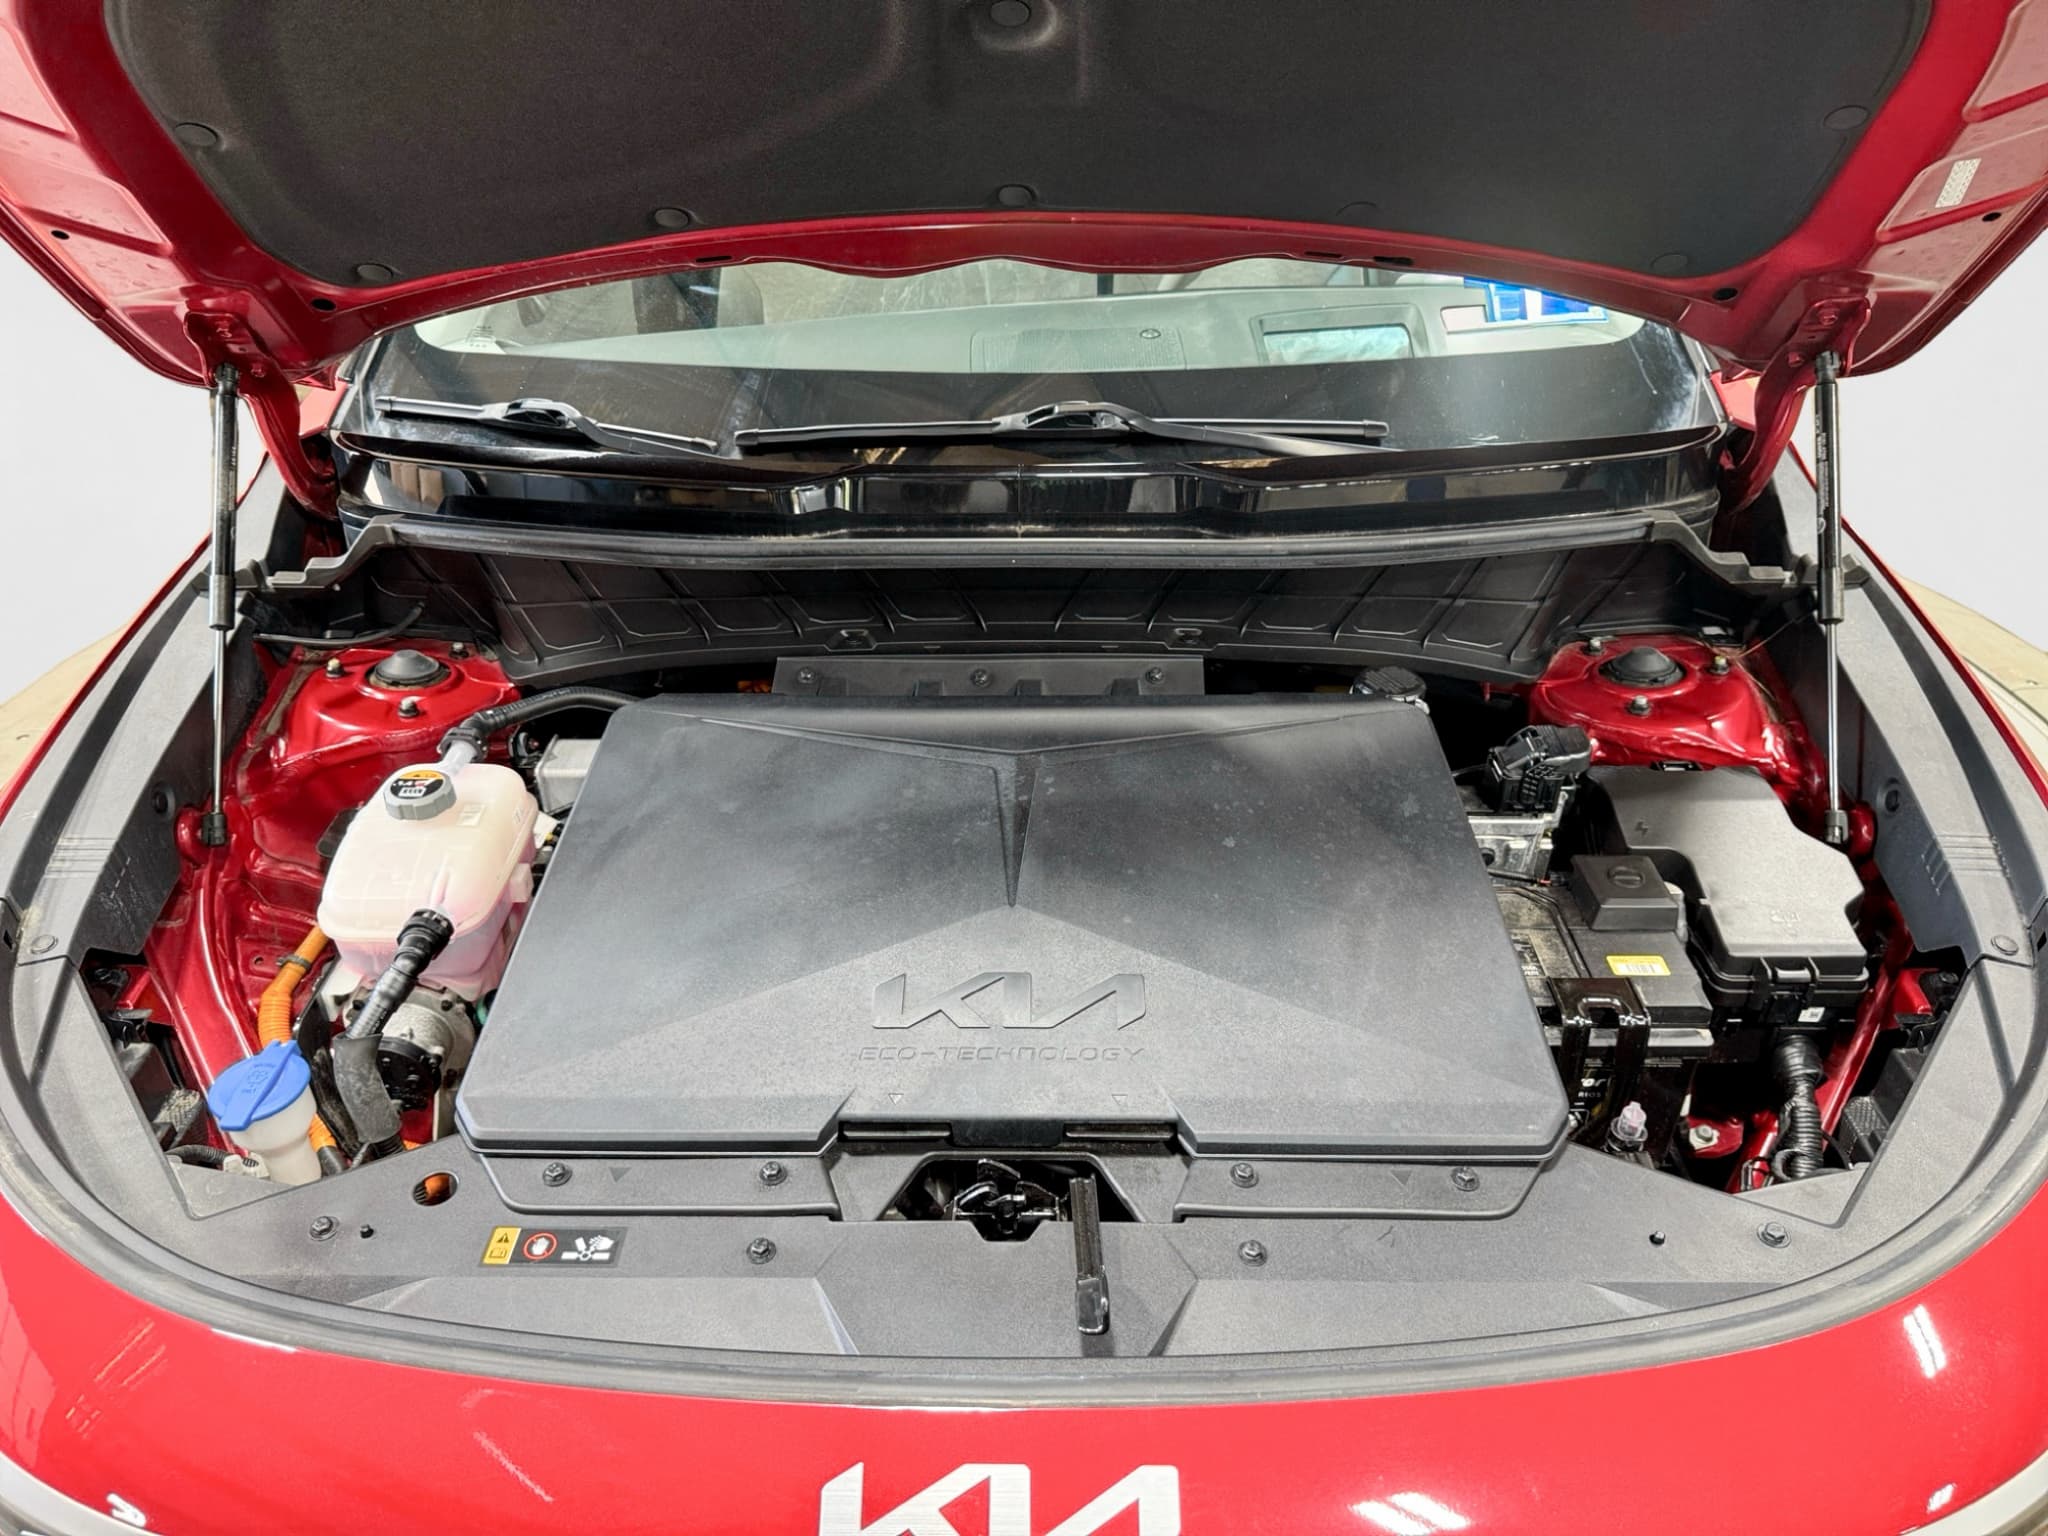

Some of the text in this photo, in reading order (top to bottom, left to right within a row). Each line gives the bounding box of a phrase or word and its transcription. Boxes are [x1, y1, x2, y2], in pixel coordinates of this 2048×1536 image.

[872, 972, 1146, 1030] KIA
[858, 1046, 1145, 1061] ECO-TECHNOLOGY
[818, 1461, 1181, 1536] KIA
